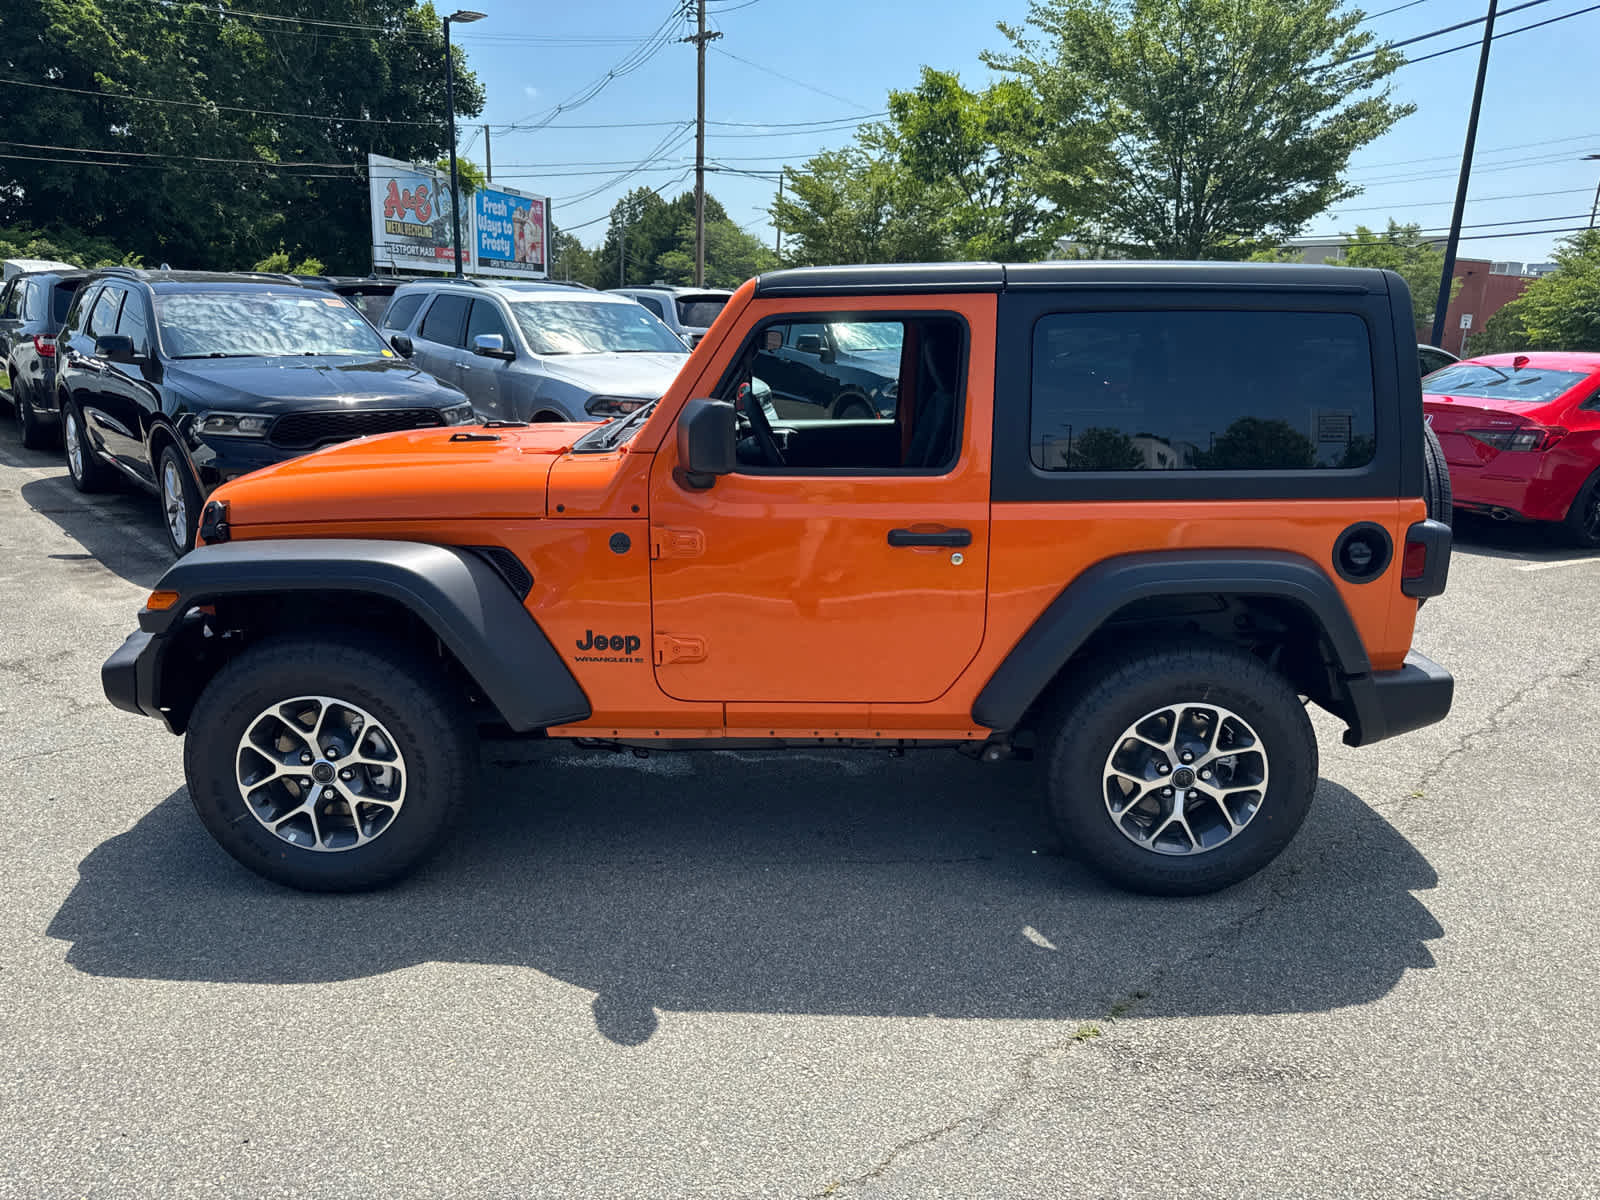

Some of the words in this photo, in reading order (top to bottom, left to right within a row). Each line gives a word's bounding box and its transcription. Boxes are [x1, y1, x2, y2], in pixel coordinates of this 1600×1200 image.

[483, 196, 507, 217] Fresh
[386, 221, 405, 235] METAL
[405, 223, 433, 239] RECYCLING
[478, 214, 502, 237] Ways
[503, 219, 513, 235] to
[481, 233, 511, 257] Frosty
[576, 629, 641, 655] Jeep
